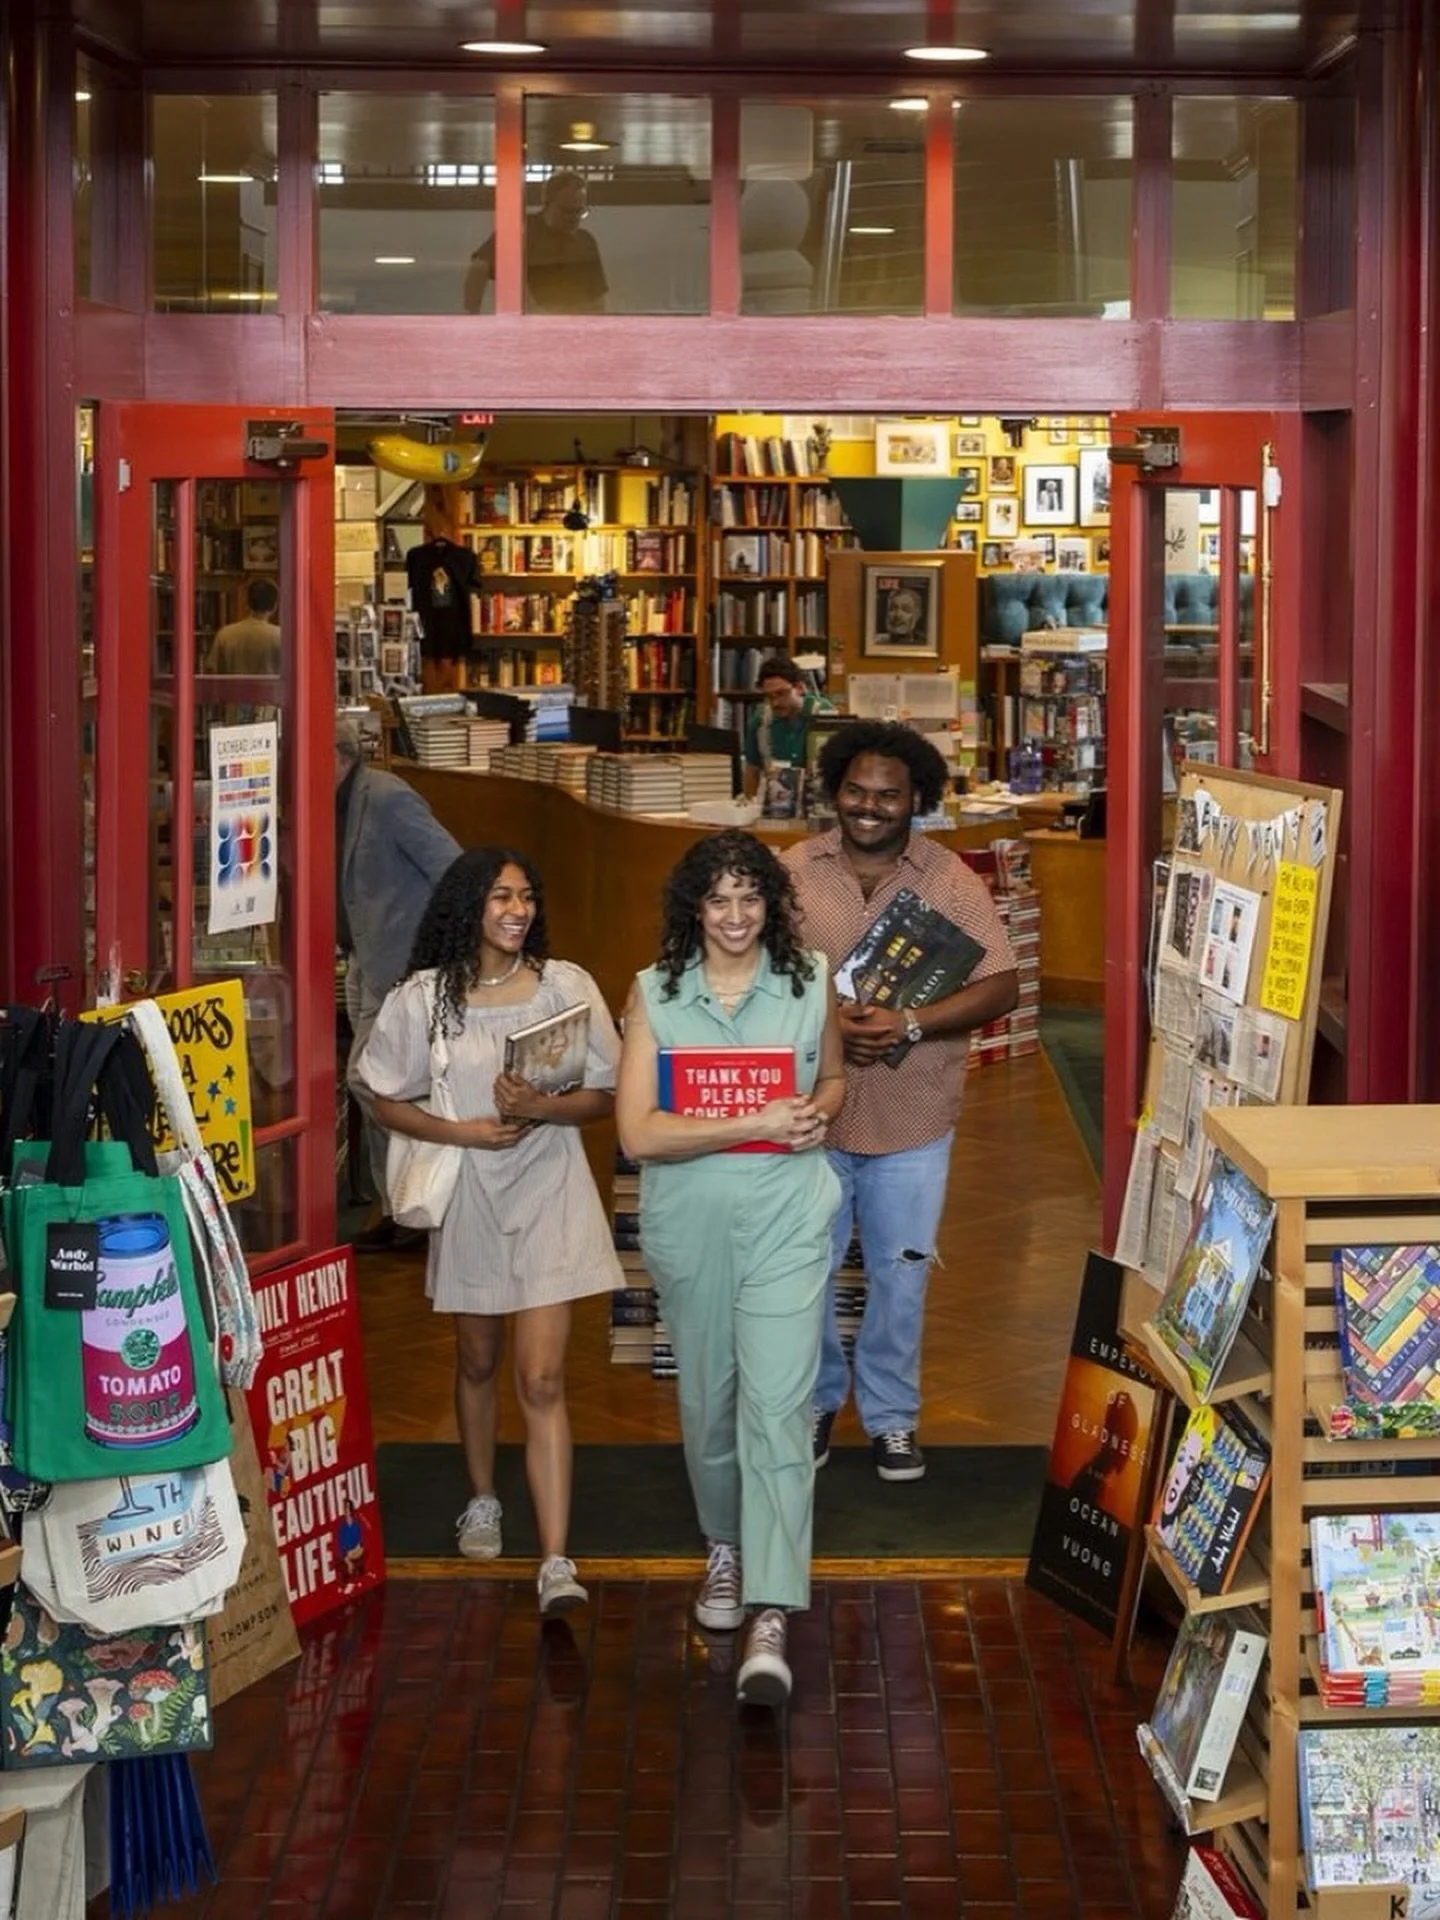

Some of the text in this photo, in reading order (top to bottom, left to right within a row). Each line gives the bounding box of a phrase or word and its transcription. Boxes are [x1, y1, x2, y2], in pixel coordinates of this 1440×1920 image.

[164, 997, 233, 1050] OOKS
[685, 1068, 782, 1085] THANK YOU
[701, 1087, 768, 1105] PLEASE
[50, 1259, 94, 1272] Warhol
[56, 1247, 89, 1261] Andy
[255, 1280, 288, 1333] MILY
[295, 1258, 348, 1318] HENRY
[98, 1365, 181, 1396] TOMATO
[266, 1348, 346, 1427] GREAT
[109, 1393, 180, 1425] SOUP
[289, 1415, 338, 1482] BIG
[1070, 1412, 1147, 1467] GLADNESS
[271, 1462, 375, 1547] EAUTIFUL
[1069, 1497, 1119, 1537] OCEAN
[106, 1519, 183, 1552] WINE
[1062, 1535, 1112, 1577] VUONG
[279, 1532, 336, 1604] LIFE
[220, 1602, 279, 1645] THOMPSON
